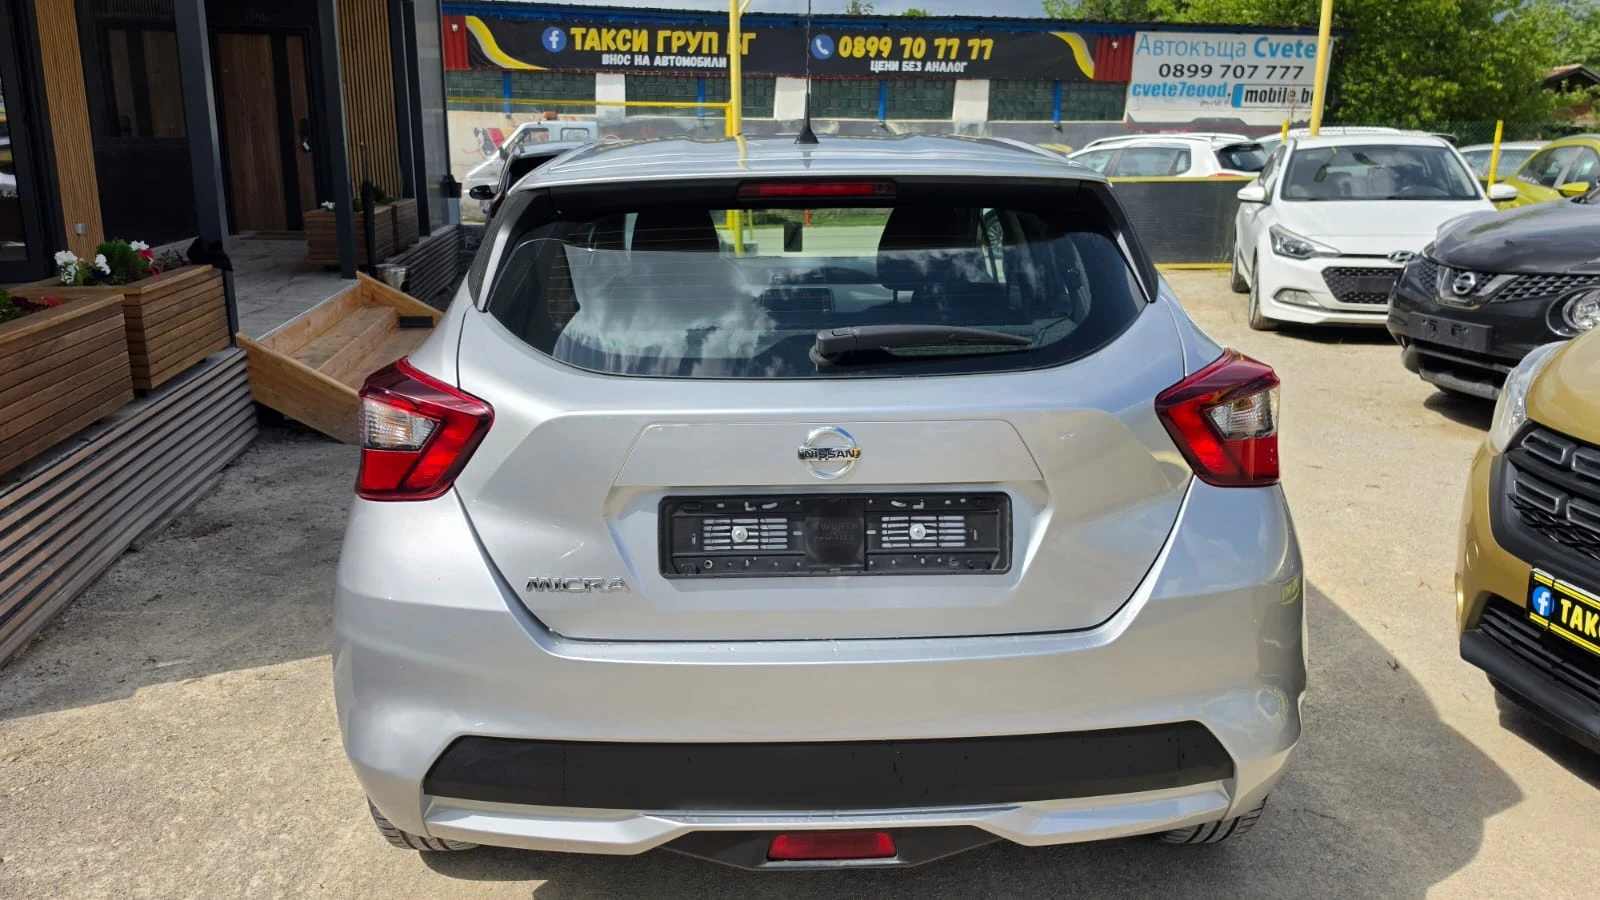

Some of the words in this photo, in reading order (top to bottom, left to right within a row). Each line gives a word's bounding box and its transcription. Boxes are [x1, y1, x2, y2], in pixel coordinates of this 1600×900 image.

[570, 27, 649, 52] ТАКСИ
[656, 30, 719, 54] ГРУП
[838, 35, 893, 58] 0899
[899, 37, 927, 59] 70
[934, 38, 960, 60] 77
[967, 38, 994, 61] 77
[1135, 34, 1247, 61] Автокъща
[1253, 37, 1317, 58] Cvete
[601, 54, 632, 66] ВНОС
[633, 55, 650, 66] НА
[653, 56, 728, 68] АВТОМОБИЛИ
[870, 60, 899, 73] ЦЕНИ
[901, 61, 923, 72] БЕЗ
[924, 61, 968, 73] АНАЛОГ
[1158, 63, 1213, 79] 0899
[1220, 64, 1259, 79] 707
[1265, 65, 1305, 80] 777
[1244, 87, 1315, 106] mobile.b
[803, 448, 855, 459] NISSAN
[526, 576, 632, 593] MICRA
[1560, 598, 1600, 638] ТАК
